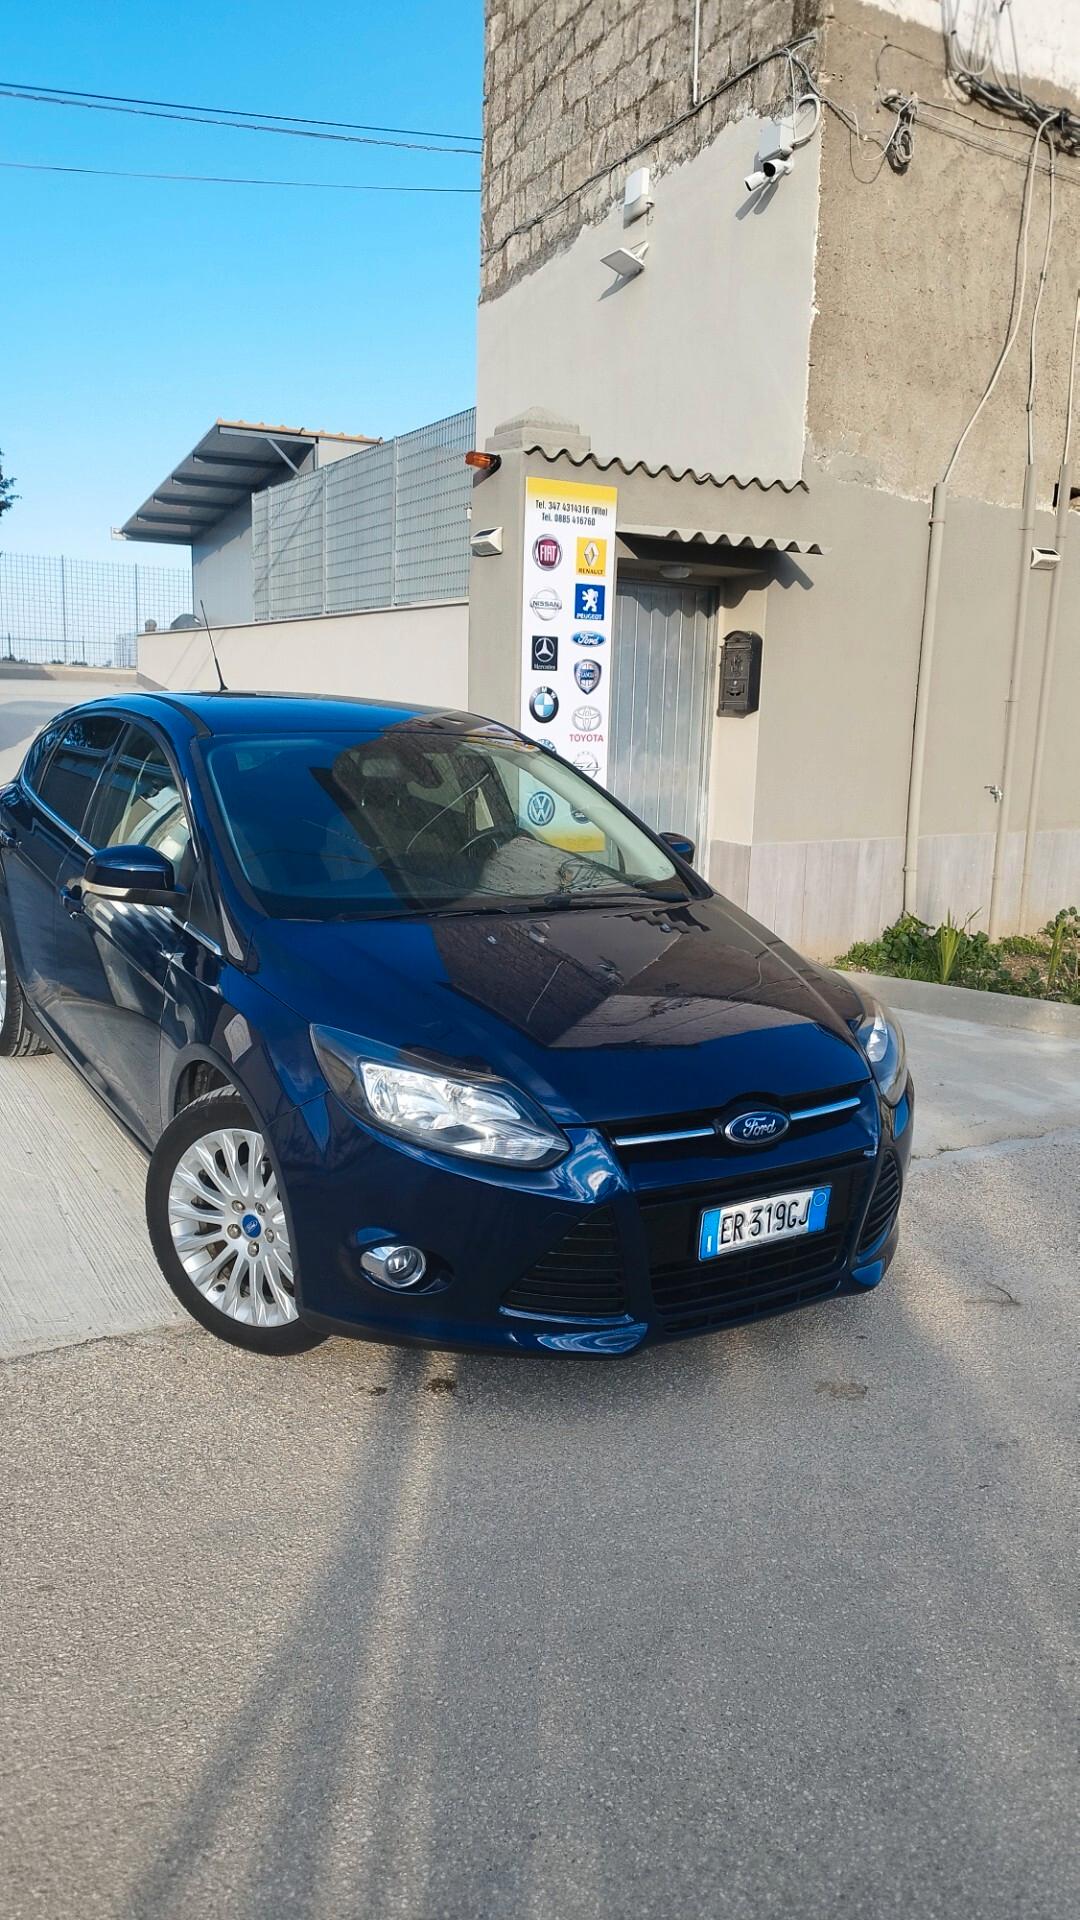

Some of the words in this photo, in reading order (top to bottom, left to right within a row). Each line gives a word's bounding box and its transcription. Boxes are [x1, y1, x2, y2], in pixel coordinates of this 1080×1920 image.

[536, 499, 547, 509] Tel.
[548, 501, 560, 511] 347
[542, 512, 552, 521] Tel.
[539, 544, 557, 562] FIAT
[578, 567, 604, 575] RENAULT
[533, 600, 560, 608] NISSAN
[577, 633, 599, 645] Ford
[569, 733, 604, 743] TOYOTA
[743, 1117, 776, 1137] Ford
[720, 1209, 745, 1245] ER
[751, 1198, 812, 1237] 319GJ
